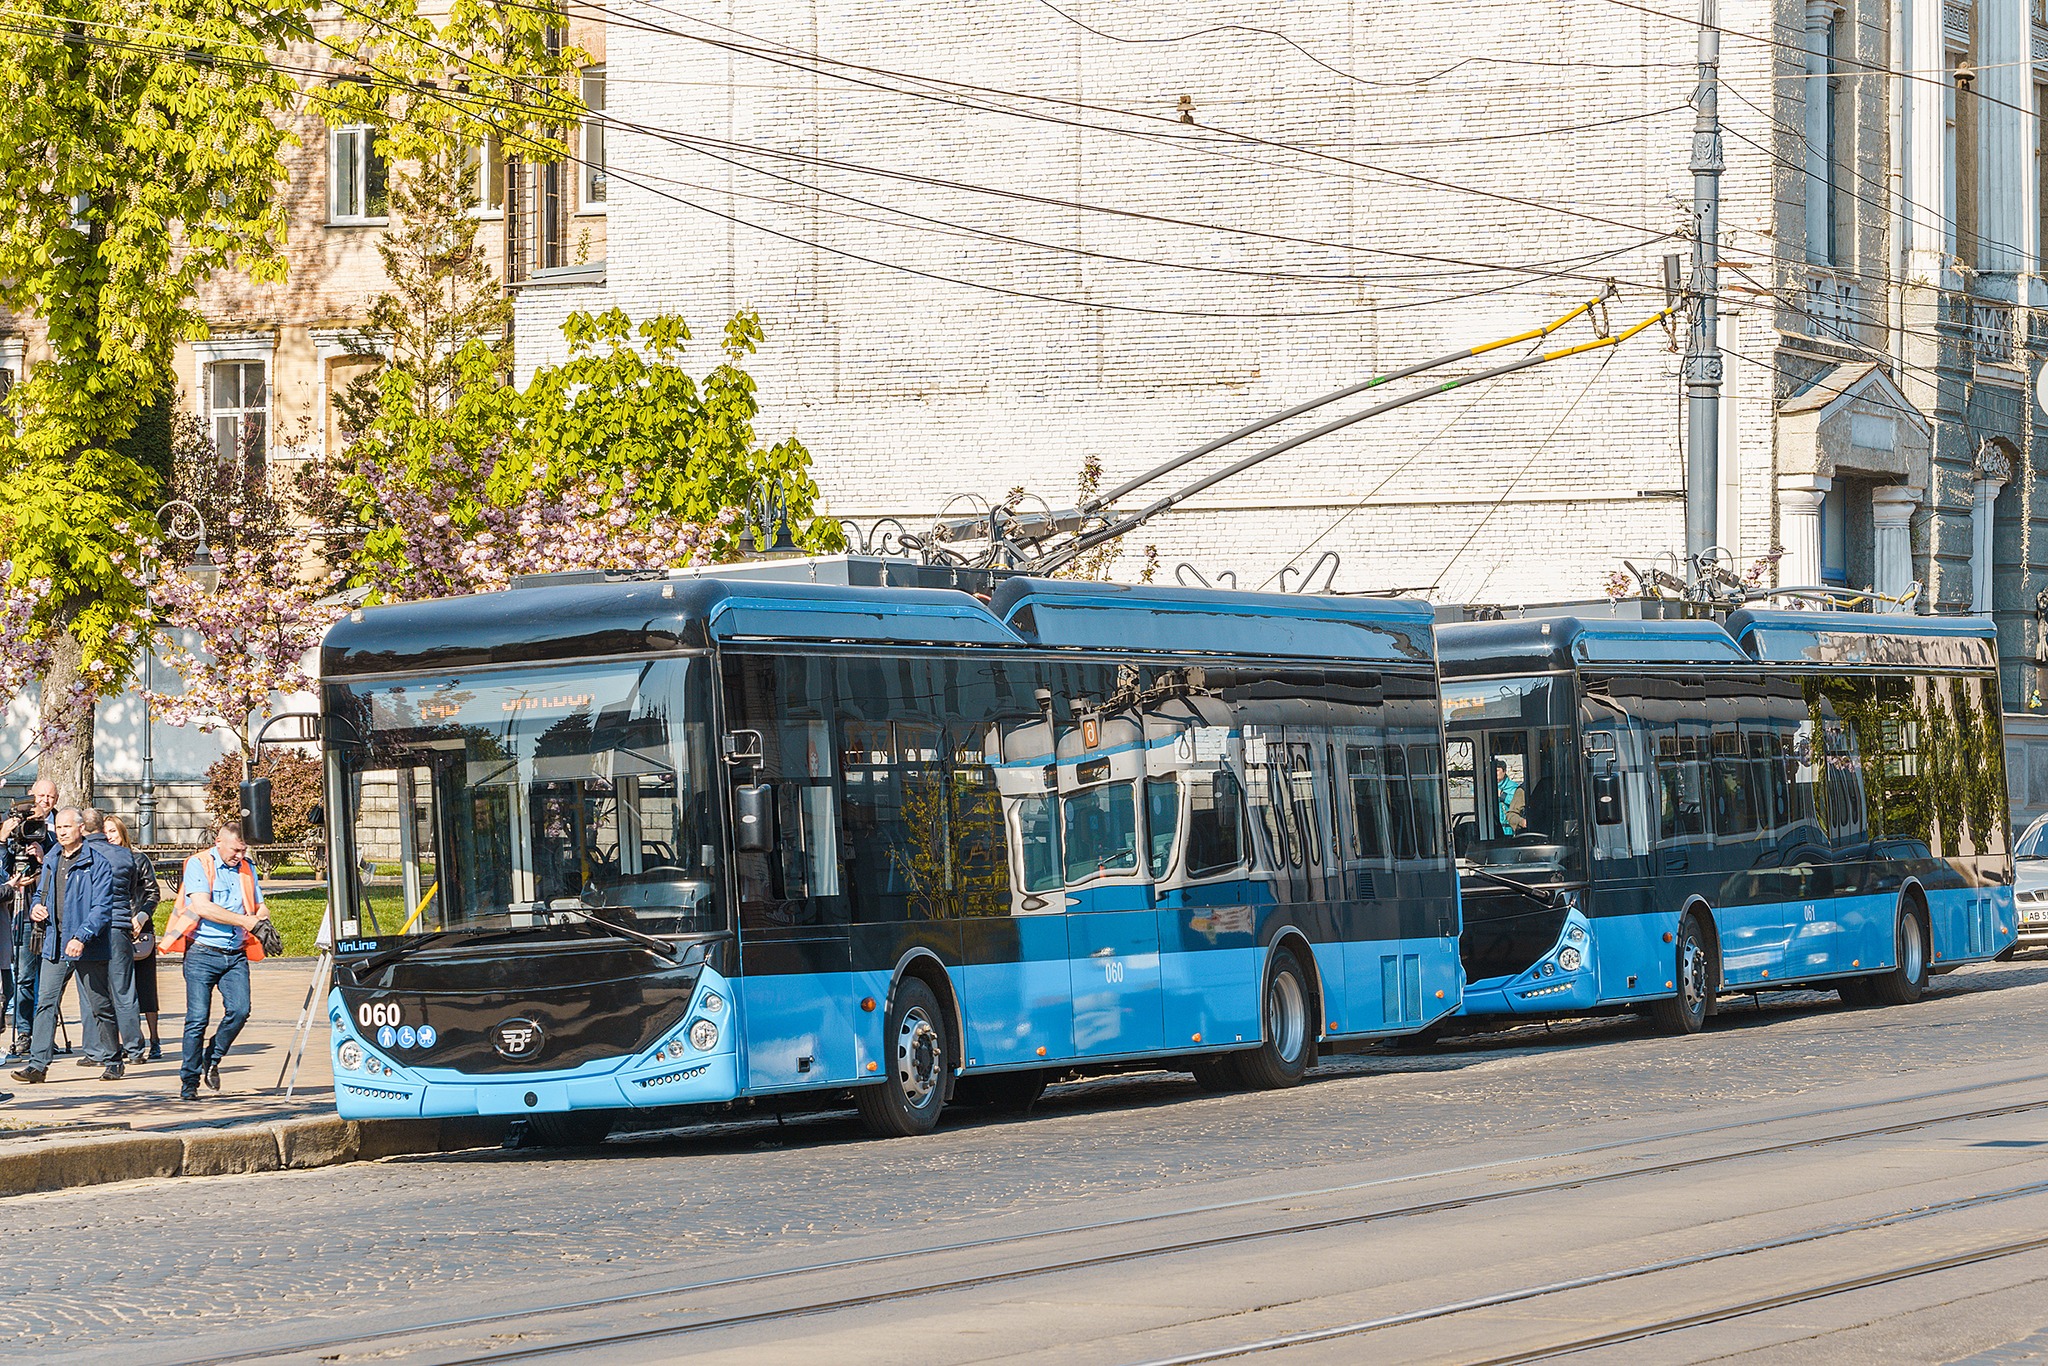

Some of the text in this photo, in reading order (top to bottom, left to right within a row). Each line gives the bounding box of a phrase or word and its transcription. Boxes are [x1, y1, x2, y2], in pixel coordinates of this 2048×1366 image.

[1804, 904, 1816, 921] 061
[338, 940, 377, 952] VinLine
[1105, 961, 1124, 984] 060
[359, 1003, 400, 1026] 060
